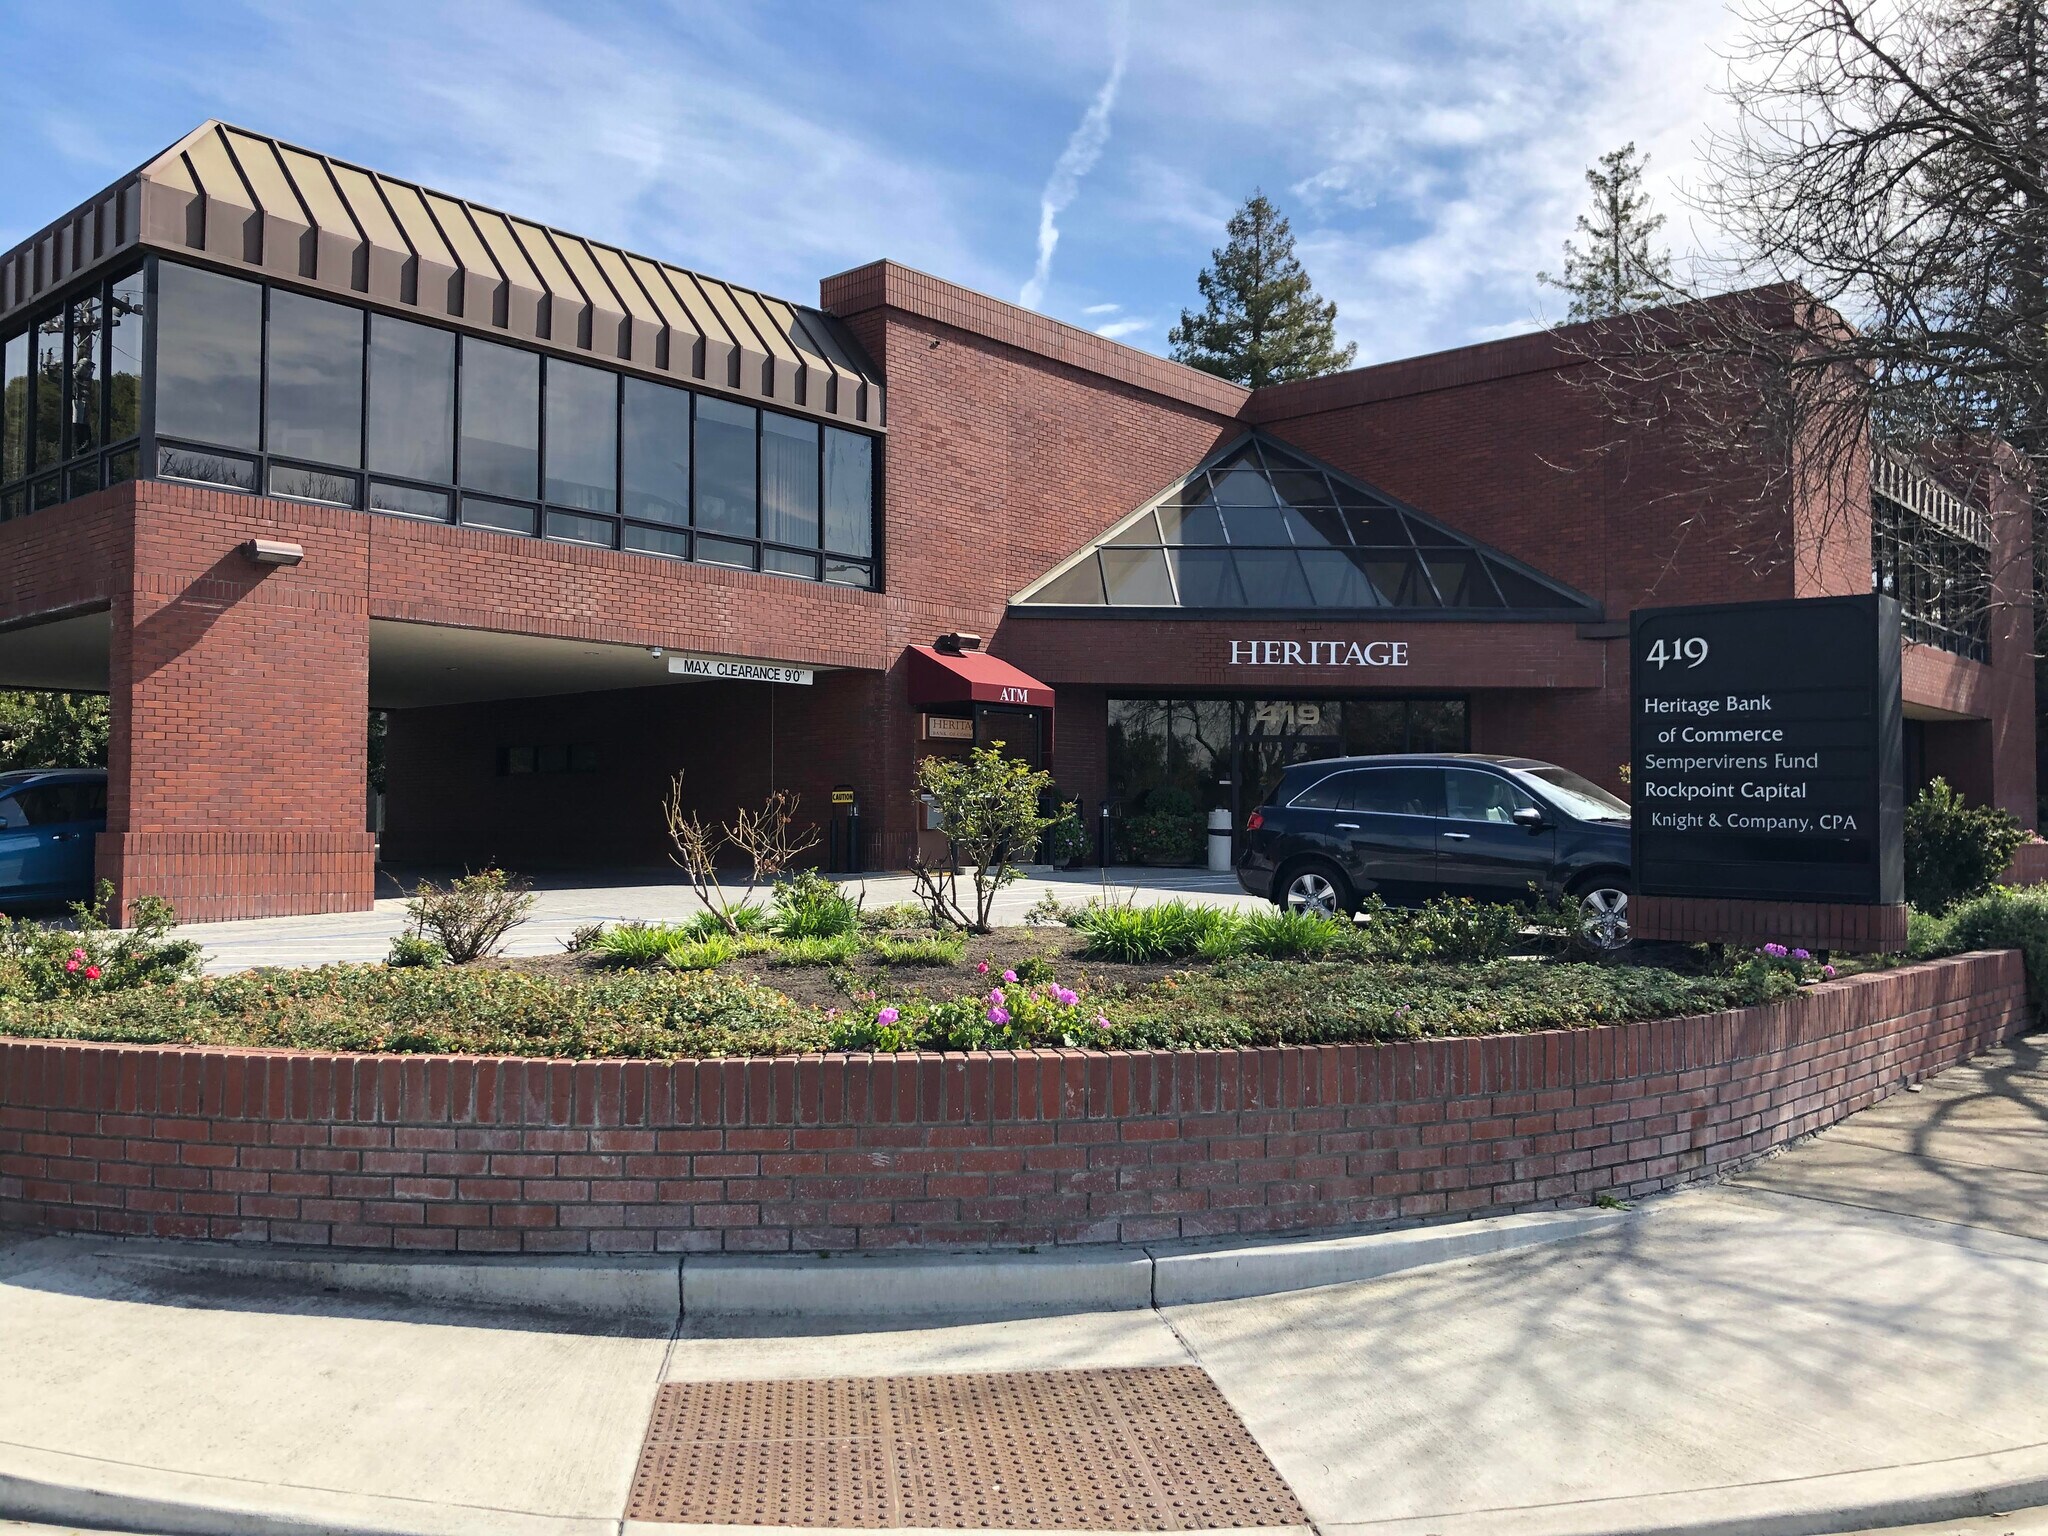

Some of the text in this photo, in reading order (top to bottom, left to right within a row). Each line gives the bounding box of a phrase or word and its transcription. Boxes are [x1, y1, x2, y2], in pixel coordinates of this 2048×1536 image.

[1228, 640, 1409, 666] HERITAGE
[1645, 637, 1709, 671] 419
[683, 659, 712, 675] MAX.
[716, 662, 781, 681] CLEARANCE
[1000, 687, 1028, 703] ATM
[1644, 694, 1772, 717] Heritage Bank
[1256, 703, 1320, 725] 419
[1658, 726, 1783, 743] of Commerce
[1645, 752, 1818, 773] Sempervirens Fund
[832, 793, 853, 801] CAUTION
[1645, 781, 1806, 802] Rockpoint Capital
[1651, 812, 1857, 833] Knight & Company, CPA
